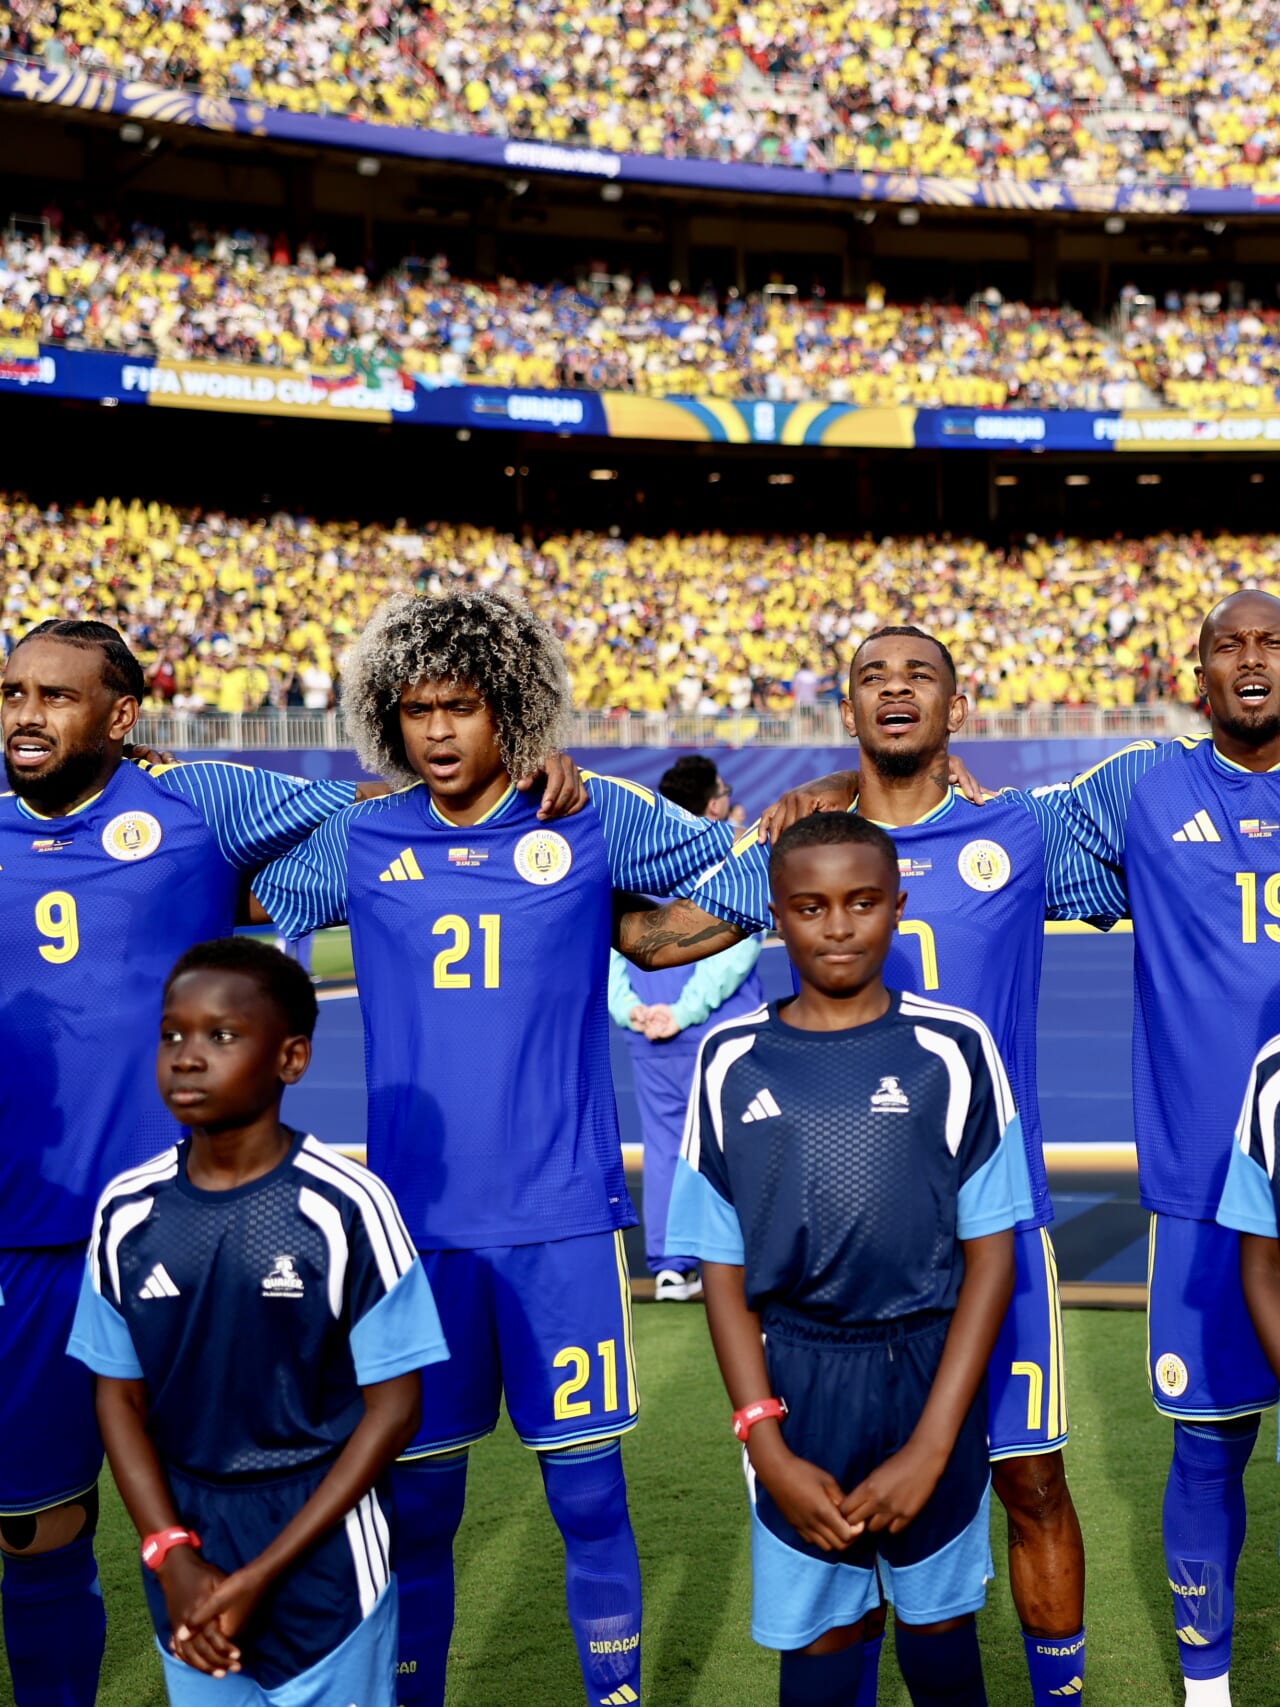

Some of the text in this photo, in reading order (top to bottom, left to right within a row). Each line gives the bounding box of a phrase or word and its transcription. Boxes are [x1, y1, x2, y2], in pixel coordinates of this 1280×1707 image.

[121, 364, 182, 395] FIFA
[181, 370, 276, 402] WORLD
[35, 891, 80, 964] 9
[432, 914, 501, 989] 21
[898, 920, 939, 990] 7
[262, 1277, 304, 1289] QUAKER
[553, 1339, 618, 1420] 21
[1011, 1361, 1043, 1430] 7
